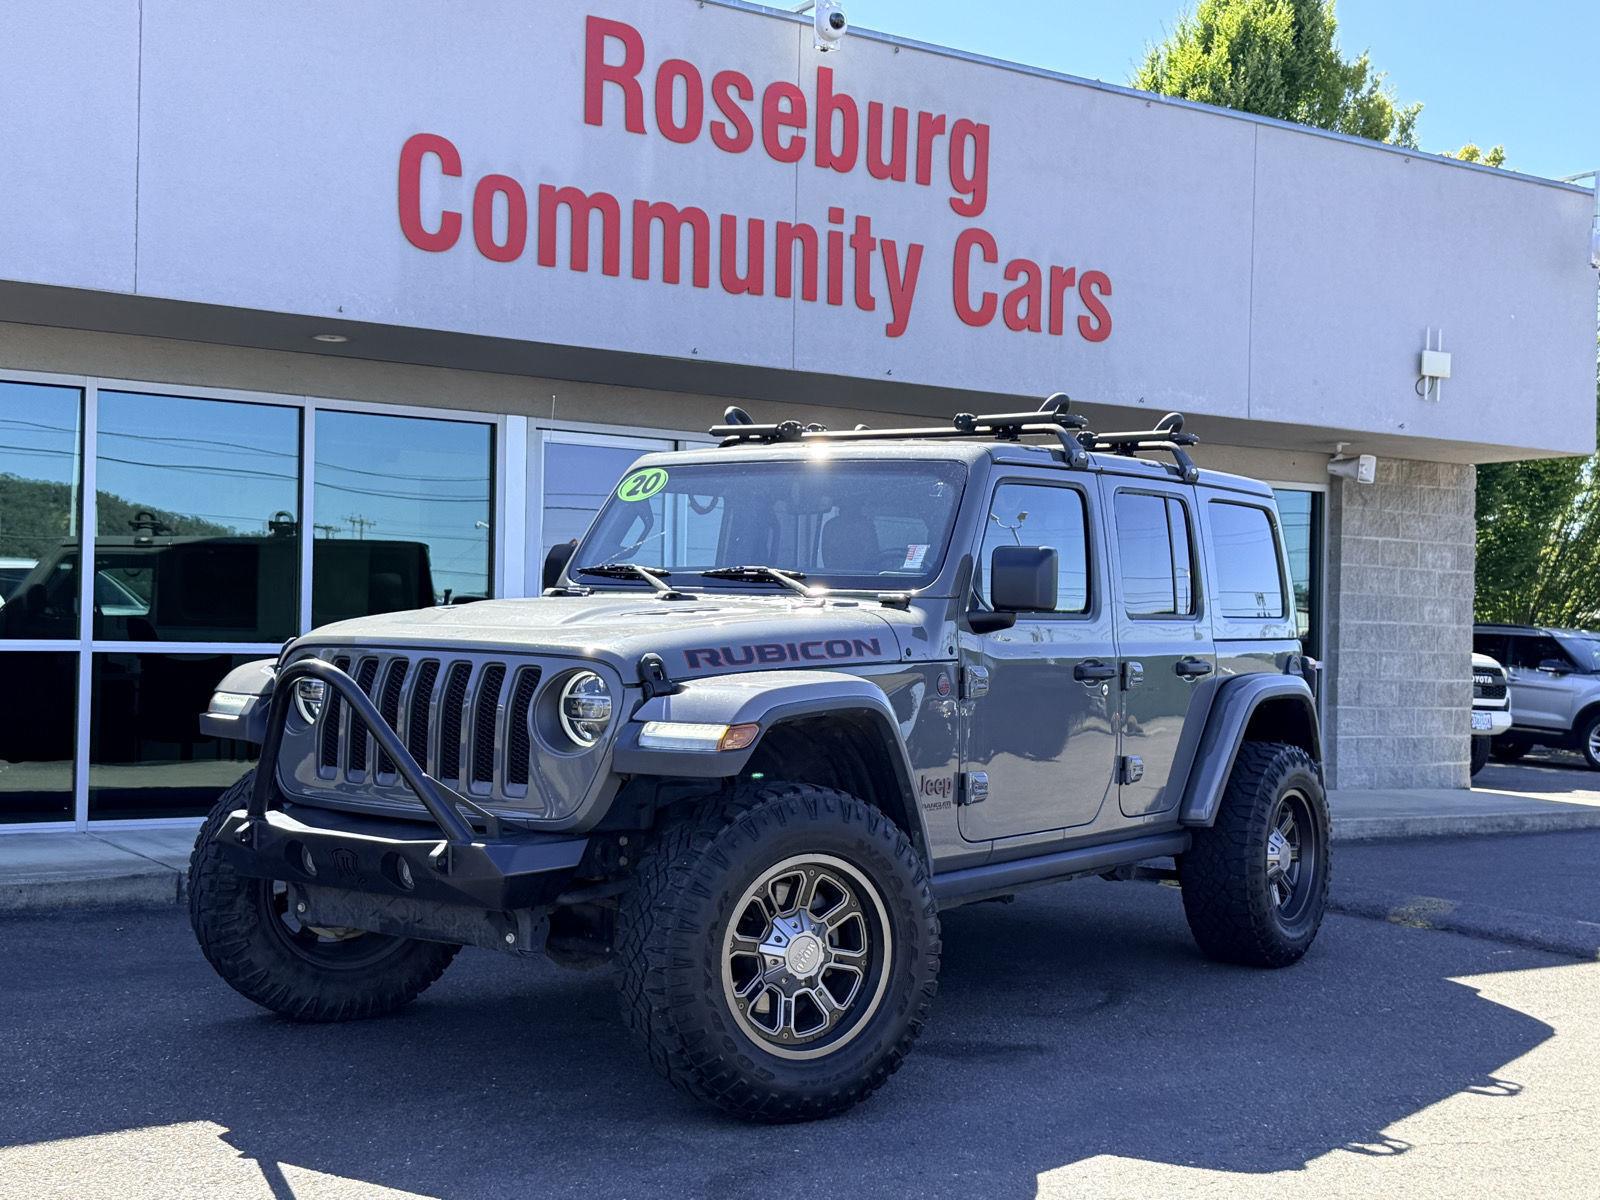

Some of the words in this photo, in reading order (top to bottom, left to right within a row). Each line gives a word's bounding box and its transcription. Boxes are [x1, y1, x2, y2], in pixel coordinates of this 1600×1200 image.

[585, 15, 990, 217] Roseburg
[399, 133, 923, 337] Community
[953, 228, 1112, 342] Cars
[626, 472, 661, 497] 20
[683, 638, 882, 669] RUBICON
[1471, 675, 1493, 684] OYOTA
[920, 775, 952, 799] Jeep
